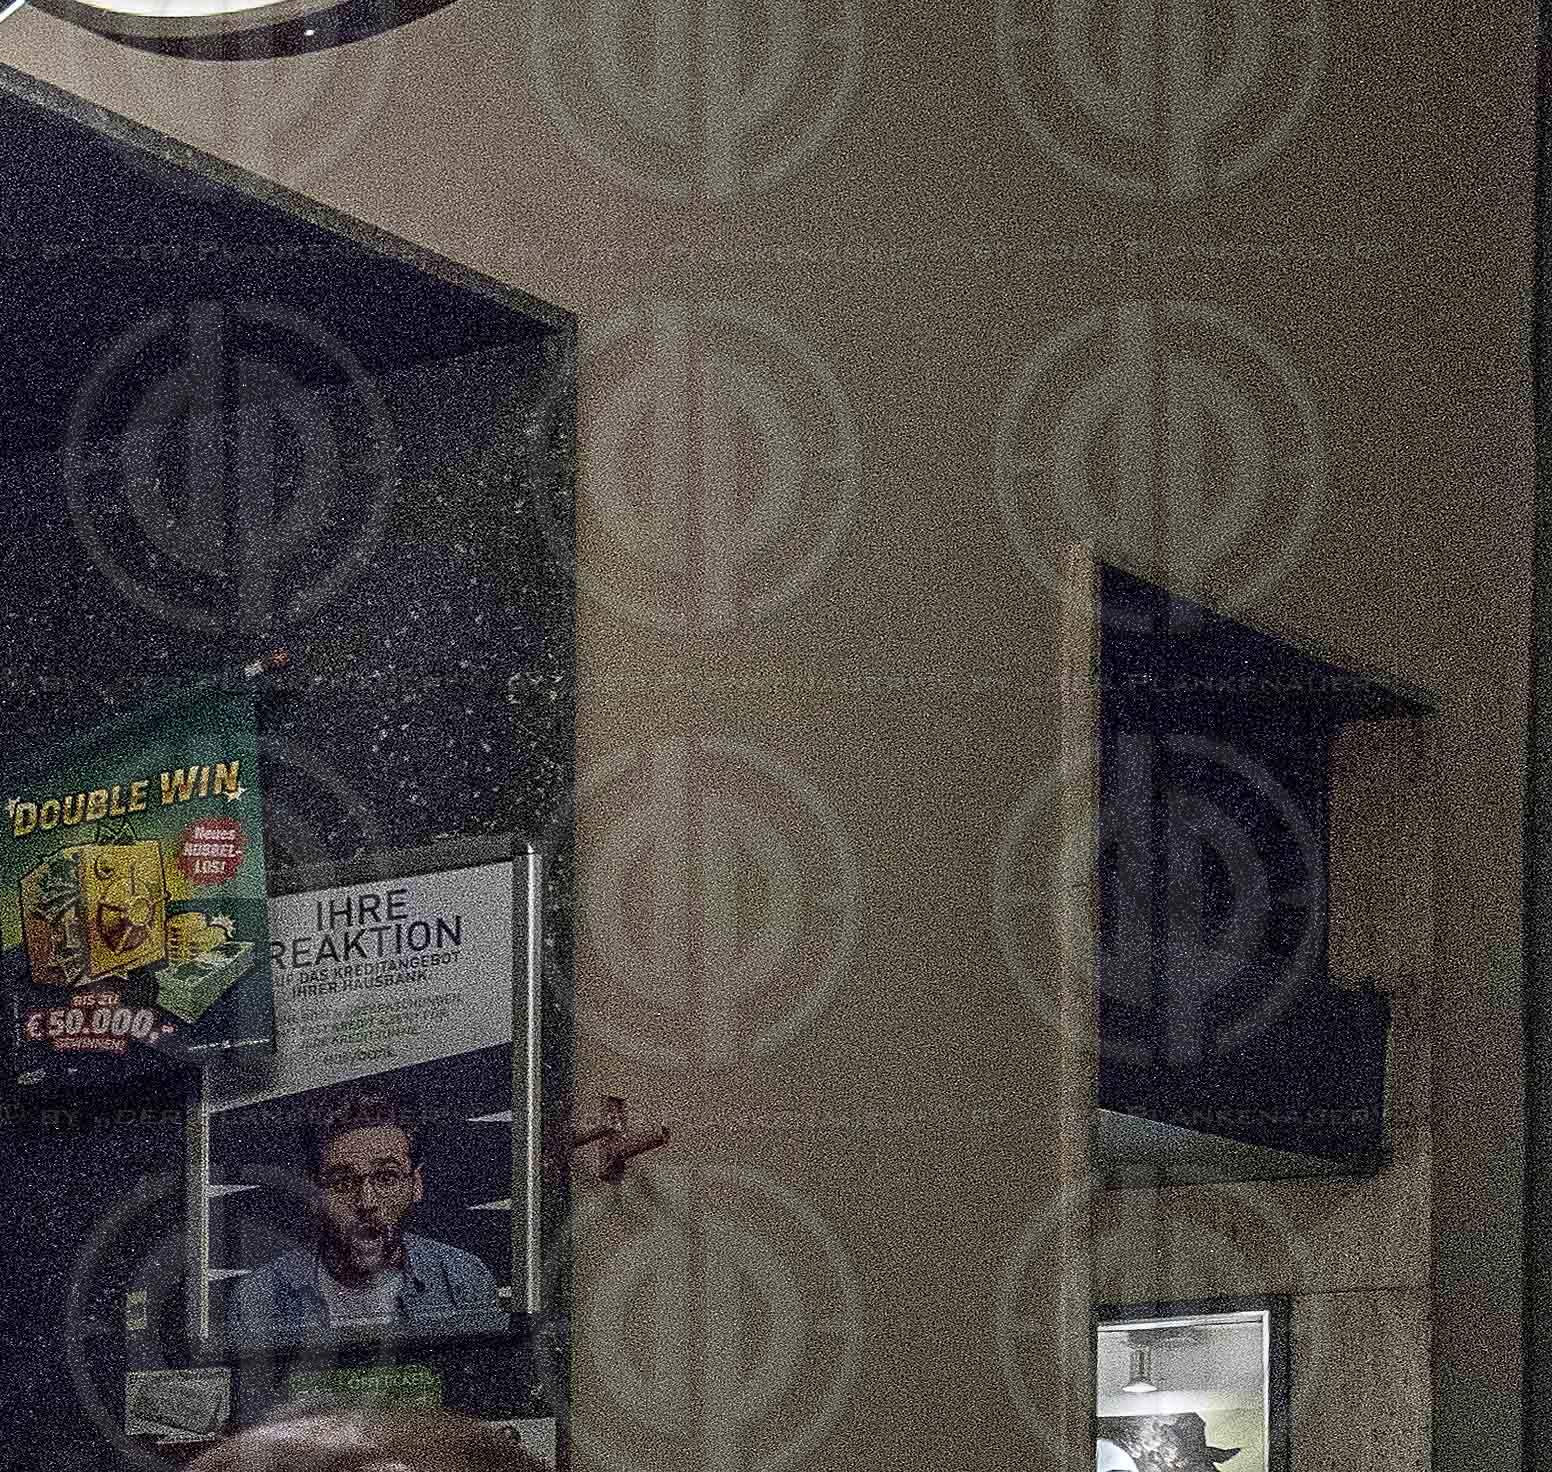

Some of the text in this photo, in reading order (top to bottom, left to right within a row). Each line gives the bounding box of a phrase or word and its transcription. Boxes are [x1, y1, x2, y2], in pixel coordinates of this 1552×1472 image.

[13, 761, 240, 837] DOUBLE WIN
[316, 888, 408, 931] IHRE
[271, 915, 462, 970] REAKTION
[272, 950, 461, 988] UF DAS KREDITANGEBOT
[292, 981, 338, 998] IHRER
